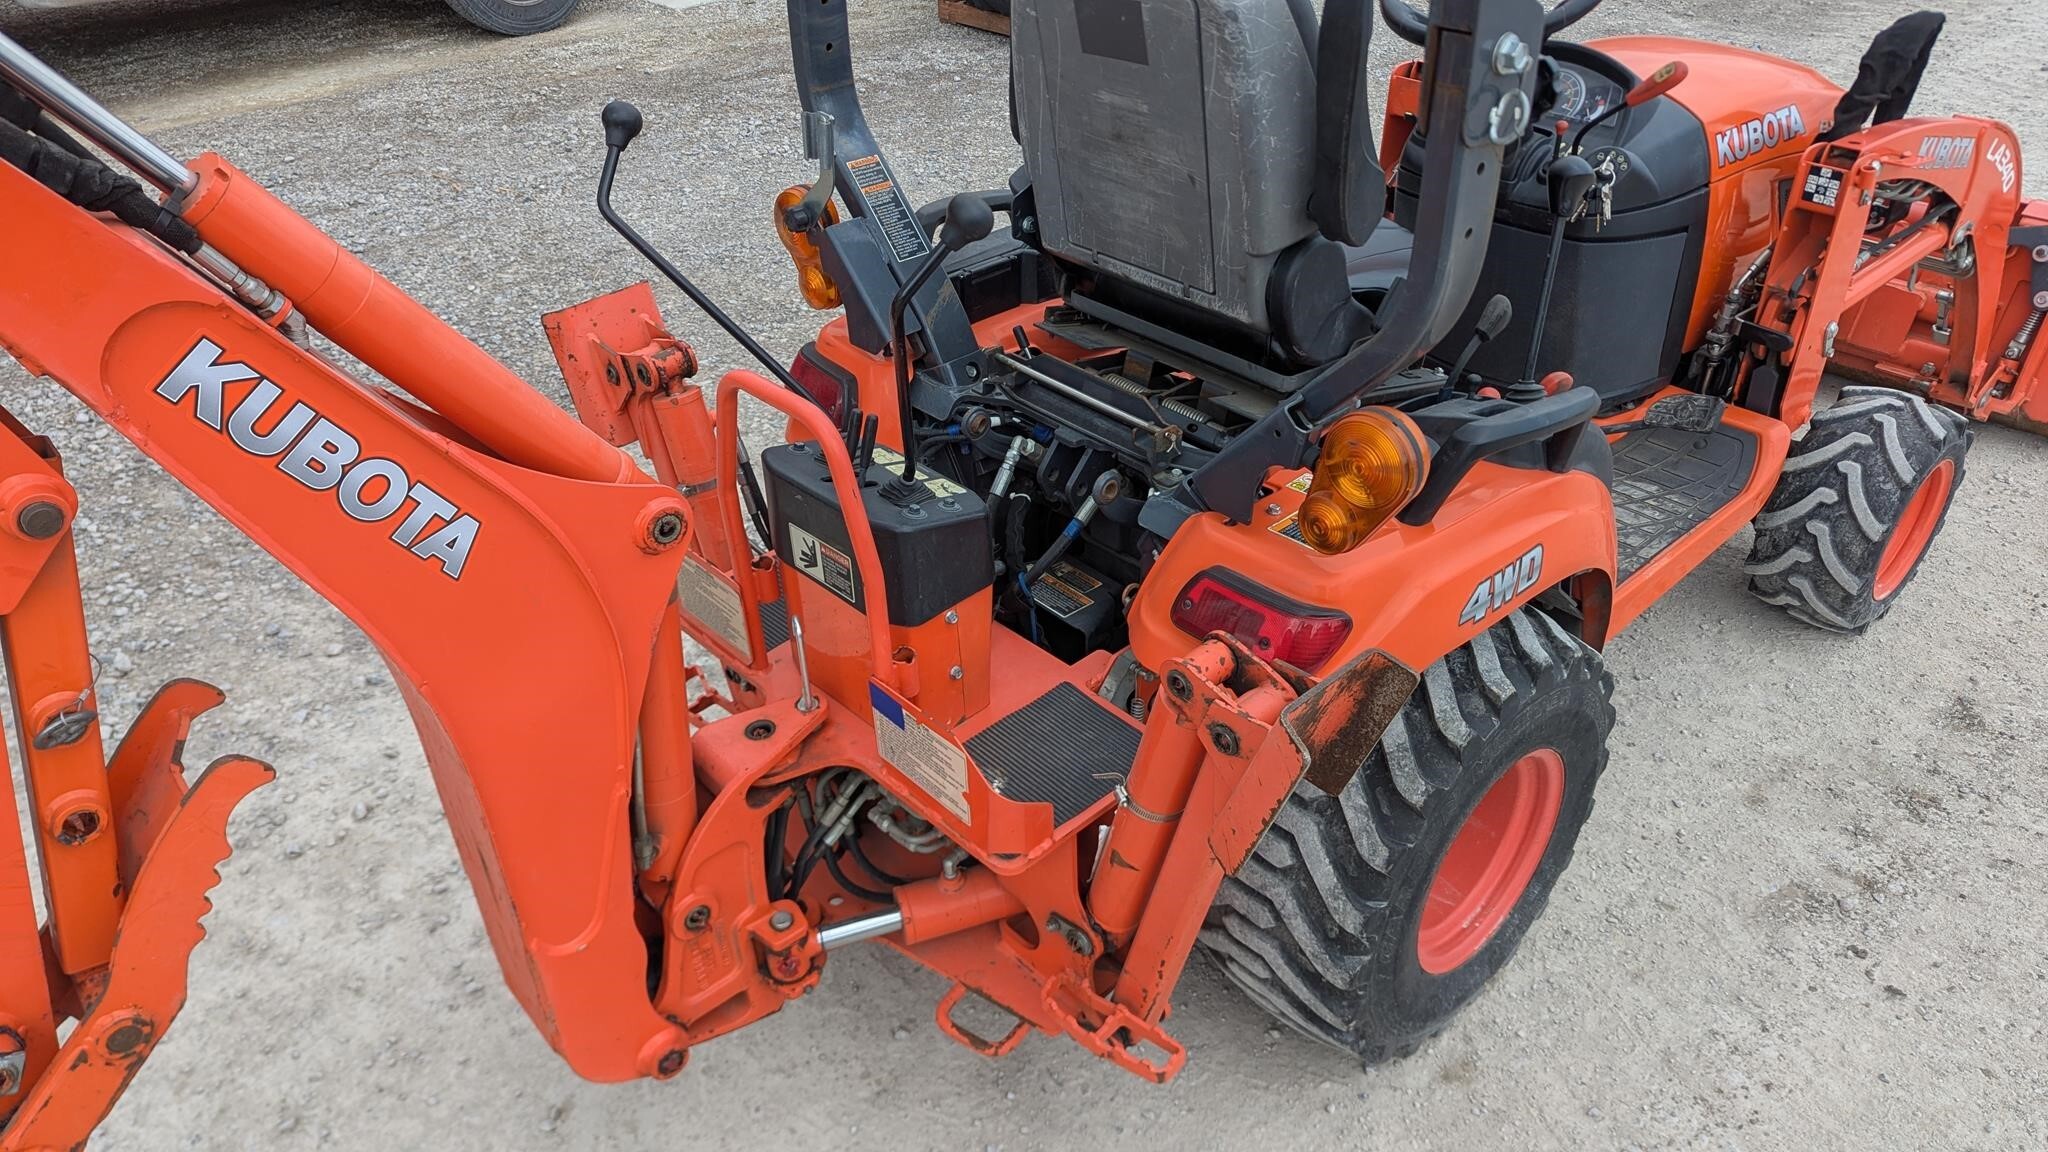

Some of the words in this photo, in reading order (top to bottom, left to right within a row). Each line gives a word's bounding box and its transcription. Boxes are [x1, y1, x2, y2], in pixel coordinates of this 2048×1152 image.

[1715, 104, 1806, 168] KUBOTA
[1913, 136, 1977, 169] KUBOTA
[1986, 137, 2016, 193] LA340
[154, 336, 482, 581] KUBOTA
[1458, 543, 1544, 626] 4WD
